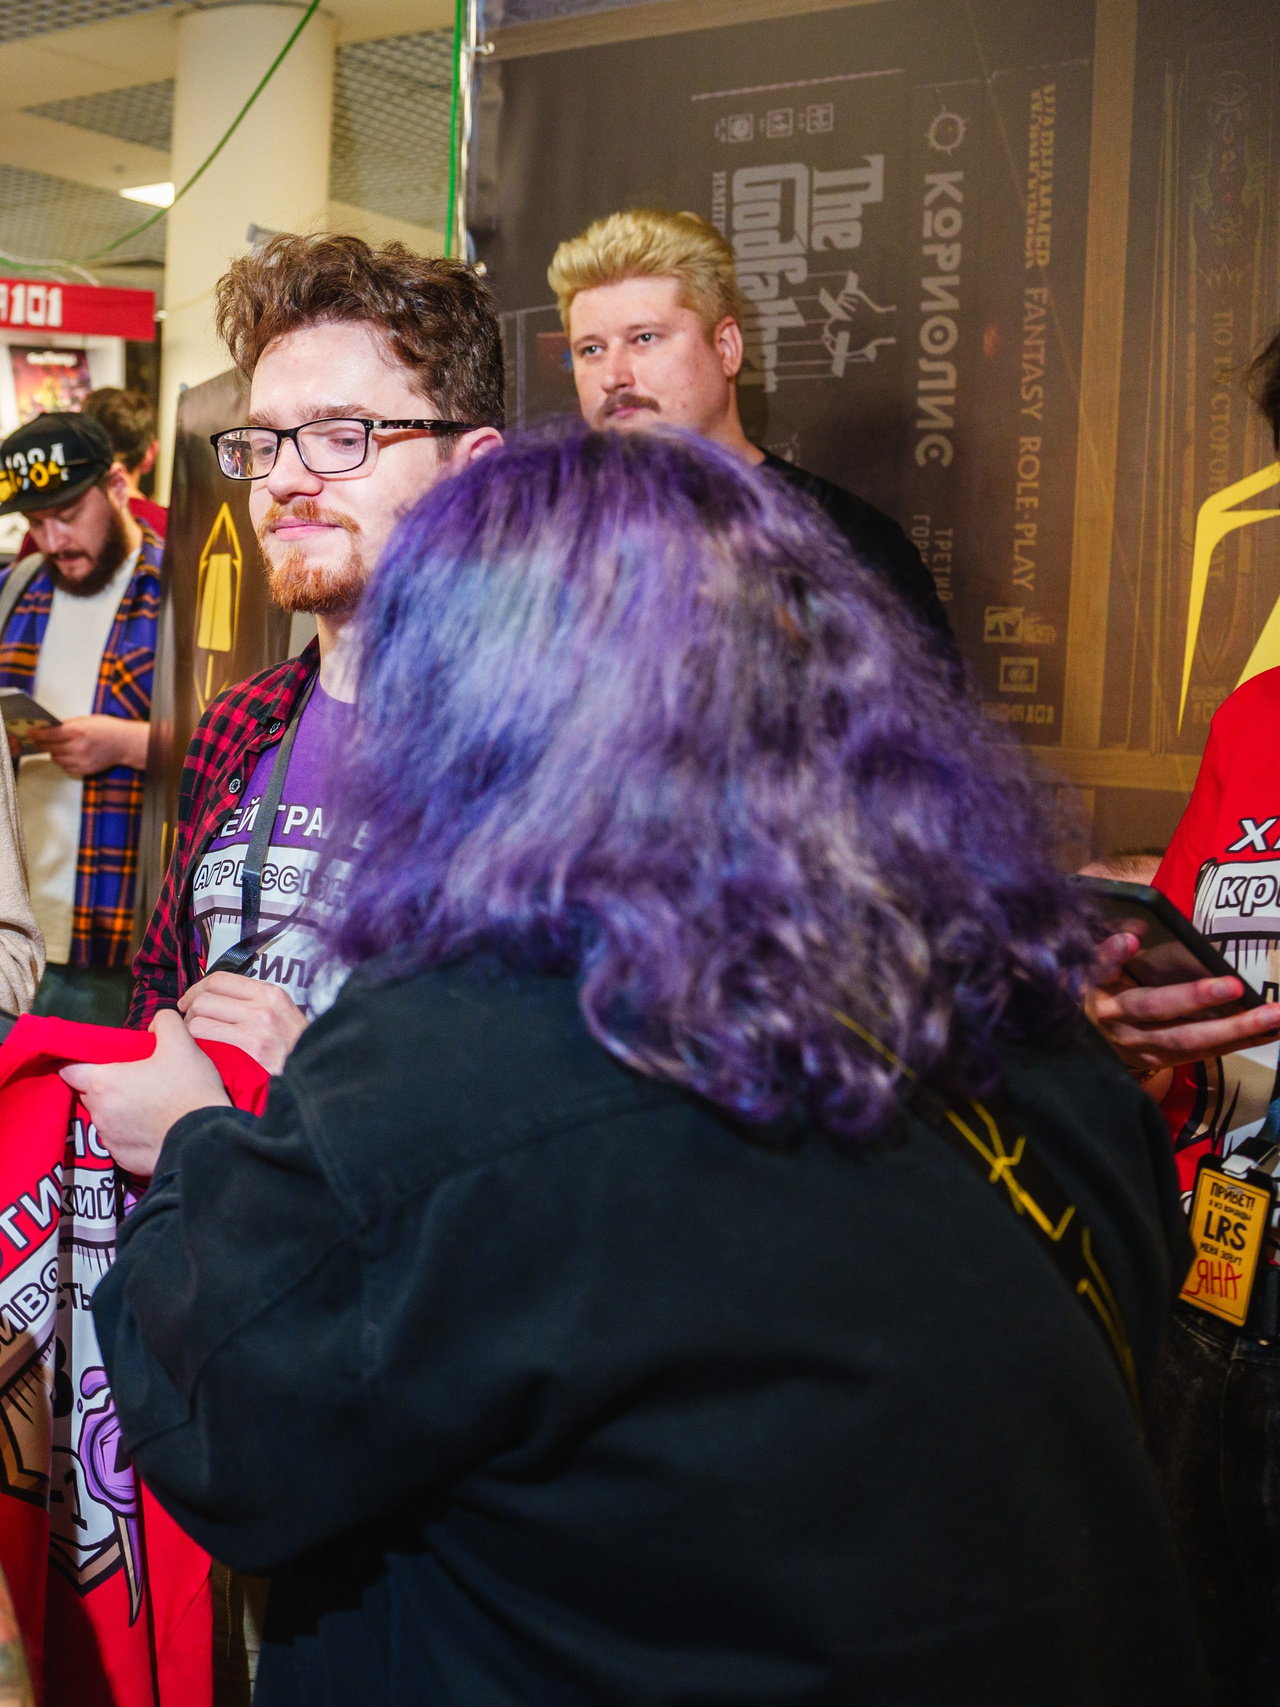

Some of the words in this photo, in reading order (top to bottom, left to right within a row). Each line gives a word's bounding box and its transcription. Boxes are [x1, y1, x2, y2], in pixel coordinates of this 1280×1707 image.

[1025, 82, 1057, 269] WARHAMMER
[811, 153, 885, 251] The
[10, 284, 62, 327] 101
[915, 171, 964, 467] КОРИОЛИС
[1019, 286, 1049, 420] FANTASY
[1225, 817, 1280, 853] Х
[1216, 874, 1280, 917] кр
[1210, 1181, 1256, 1212] ПРИВЕТ!
[1203, 1210, 1248, 1251] LRS
[1183, 1259, 1243, 1301] ЯНА
